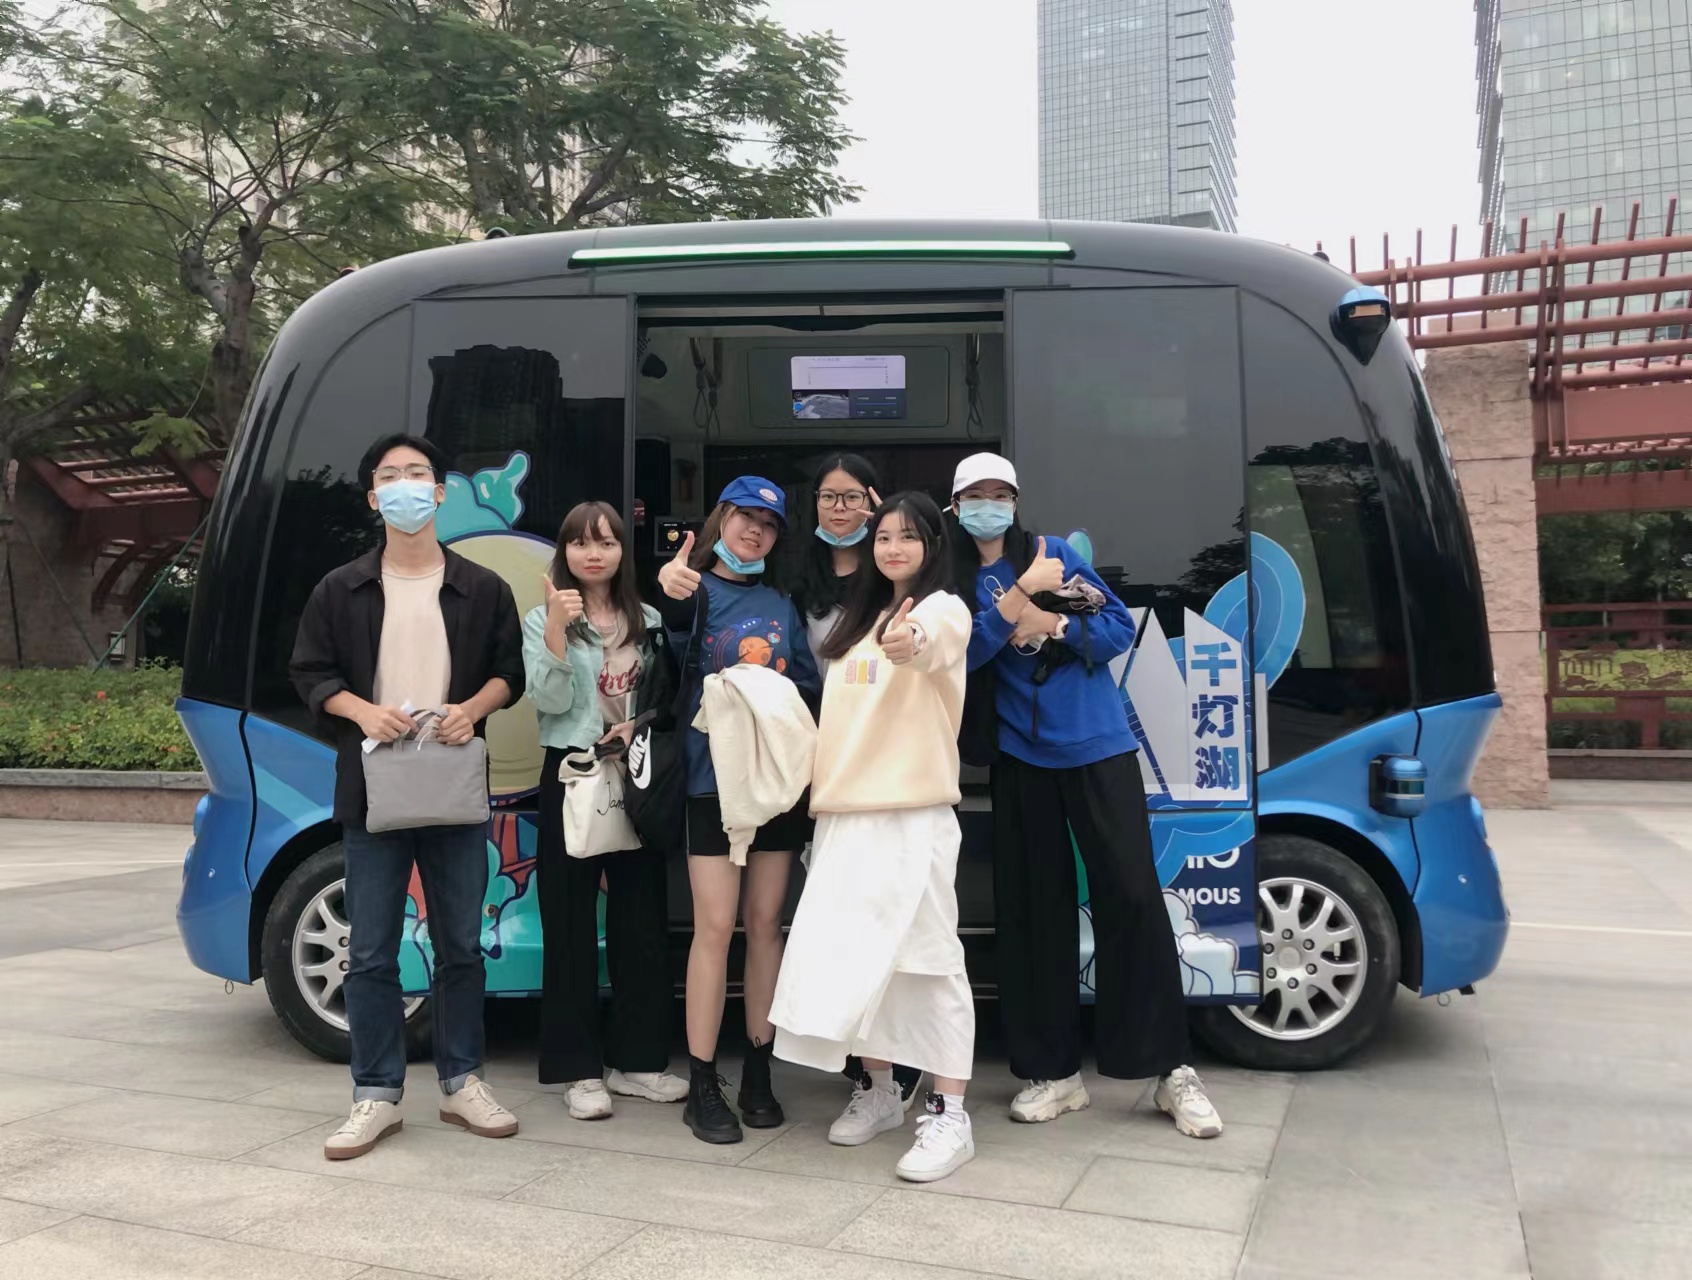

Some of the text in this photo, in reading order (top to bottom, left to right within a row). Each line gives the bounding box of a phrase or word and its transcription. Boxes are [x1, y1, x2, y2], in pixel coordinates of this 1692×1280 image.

[628, 733, 647, 778] NIKE
[1190, 641, 1240, 790] 千灯湖
